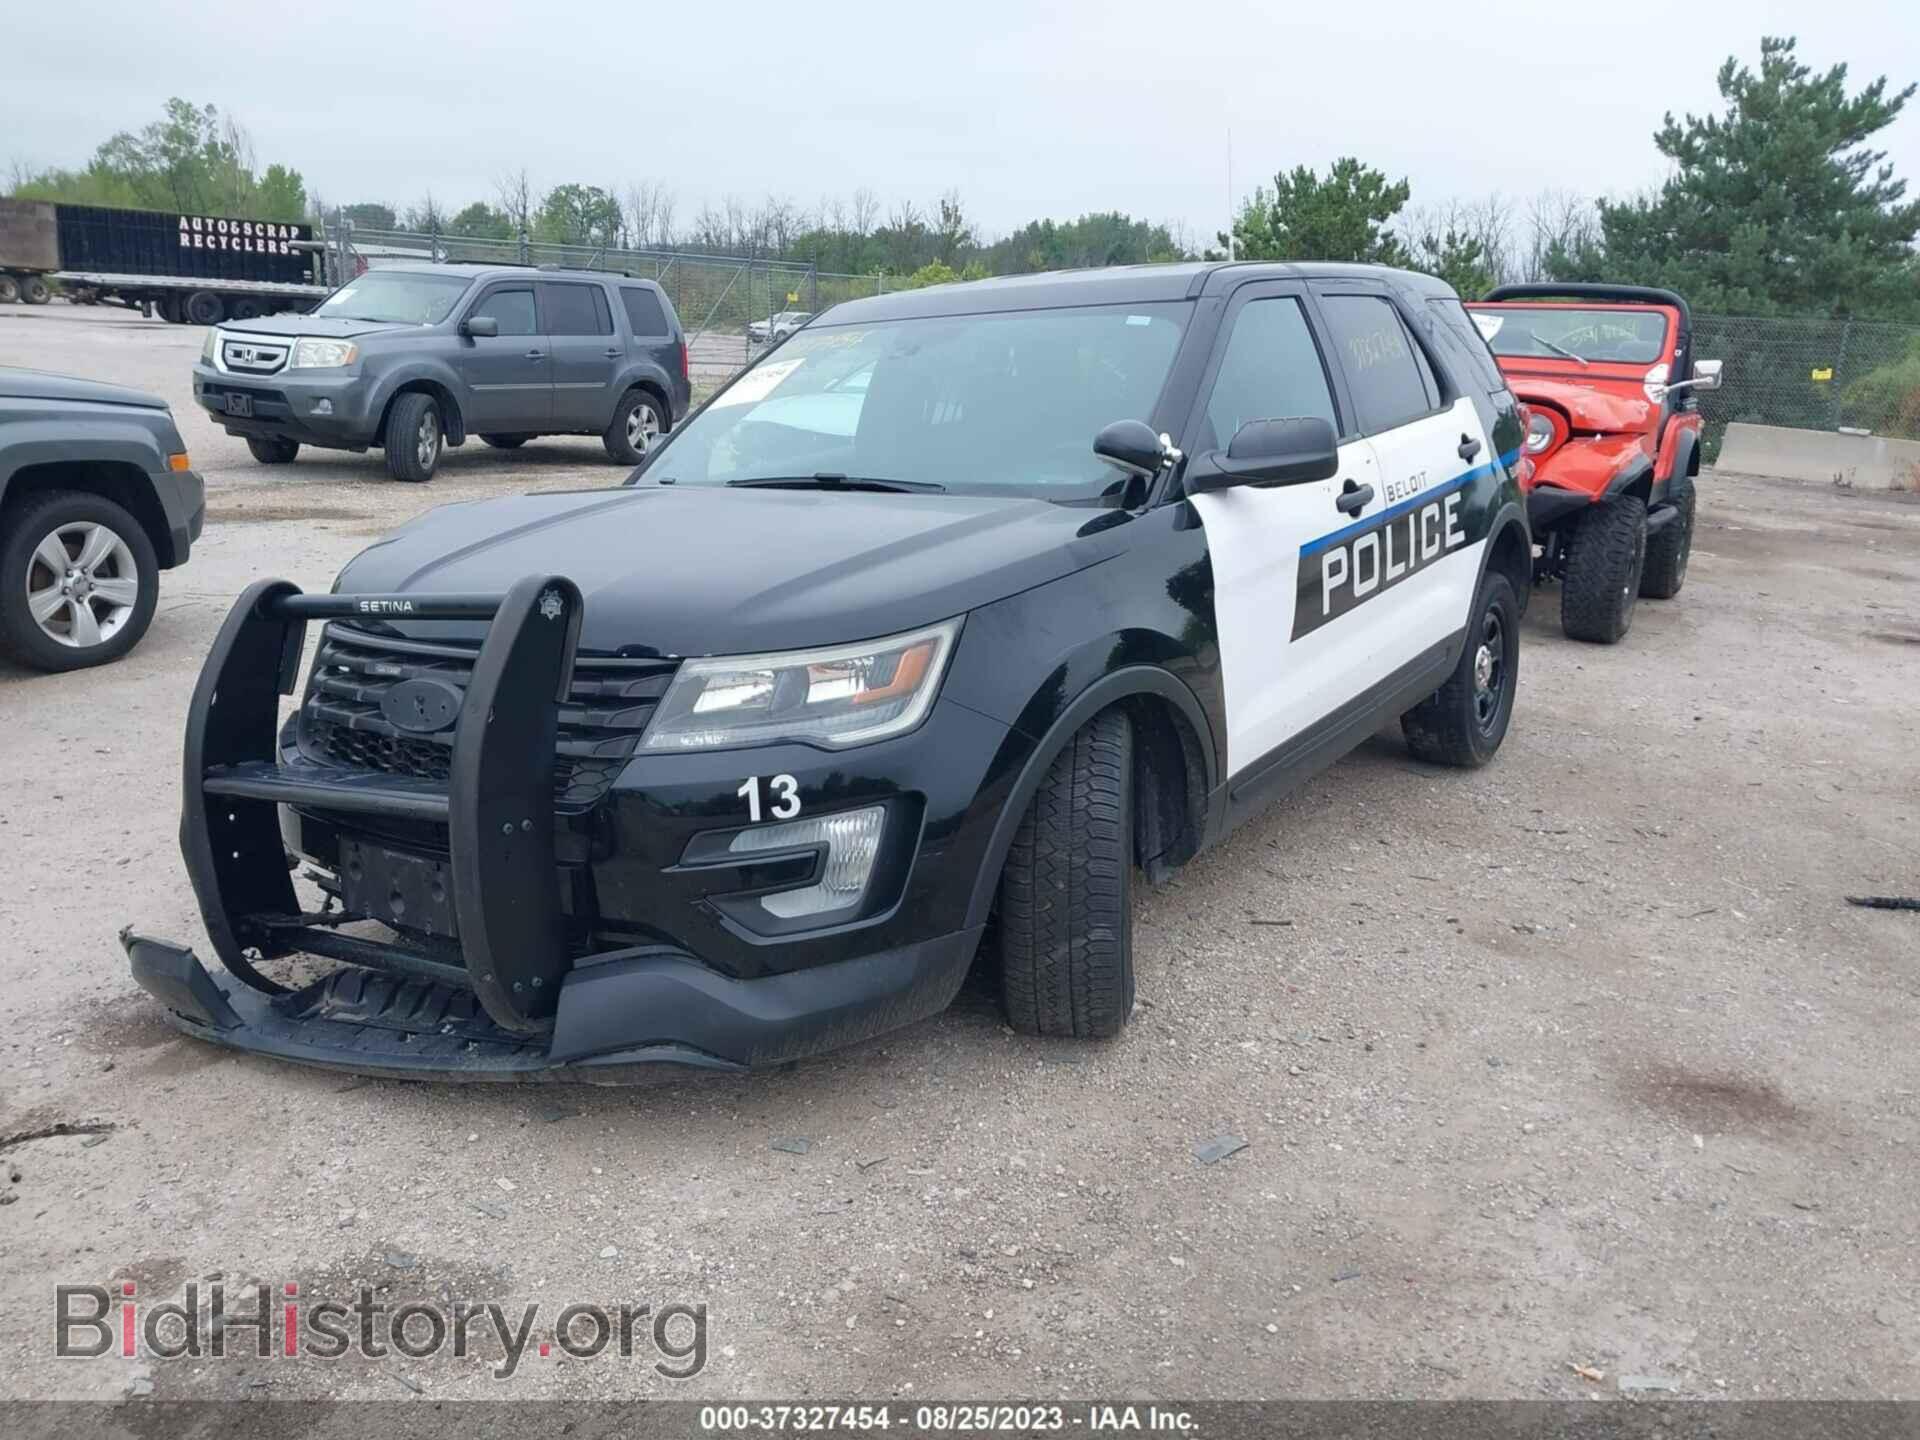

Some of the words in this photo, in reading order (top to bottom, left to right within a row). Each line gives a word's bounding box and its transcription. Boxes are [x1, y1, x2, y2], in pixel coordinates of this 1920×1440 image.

[179, 232, 289, 255] RECYCLERS
[1386, 471, 1428, 502] BELOIT
[1322, 491, 1466, 616] POLICE
[359, 600, 414, 612] SETINA
[737, 773, 801, 822] 13
